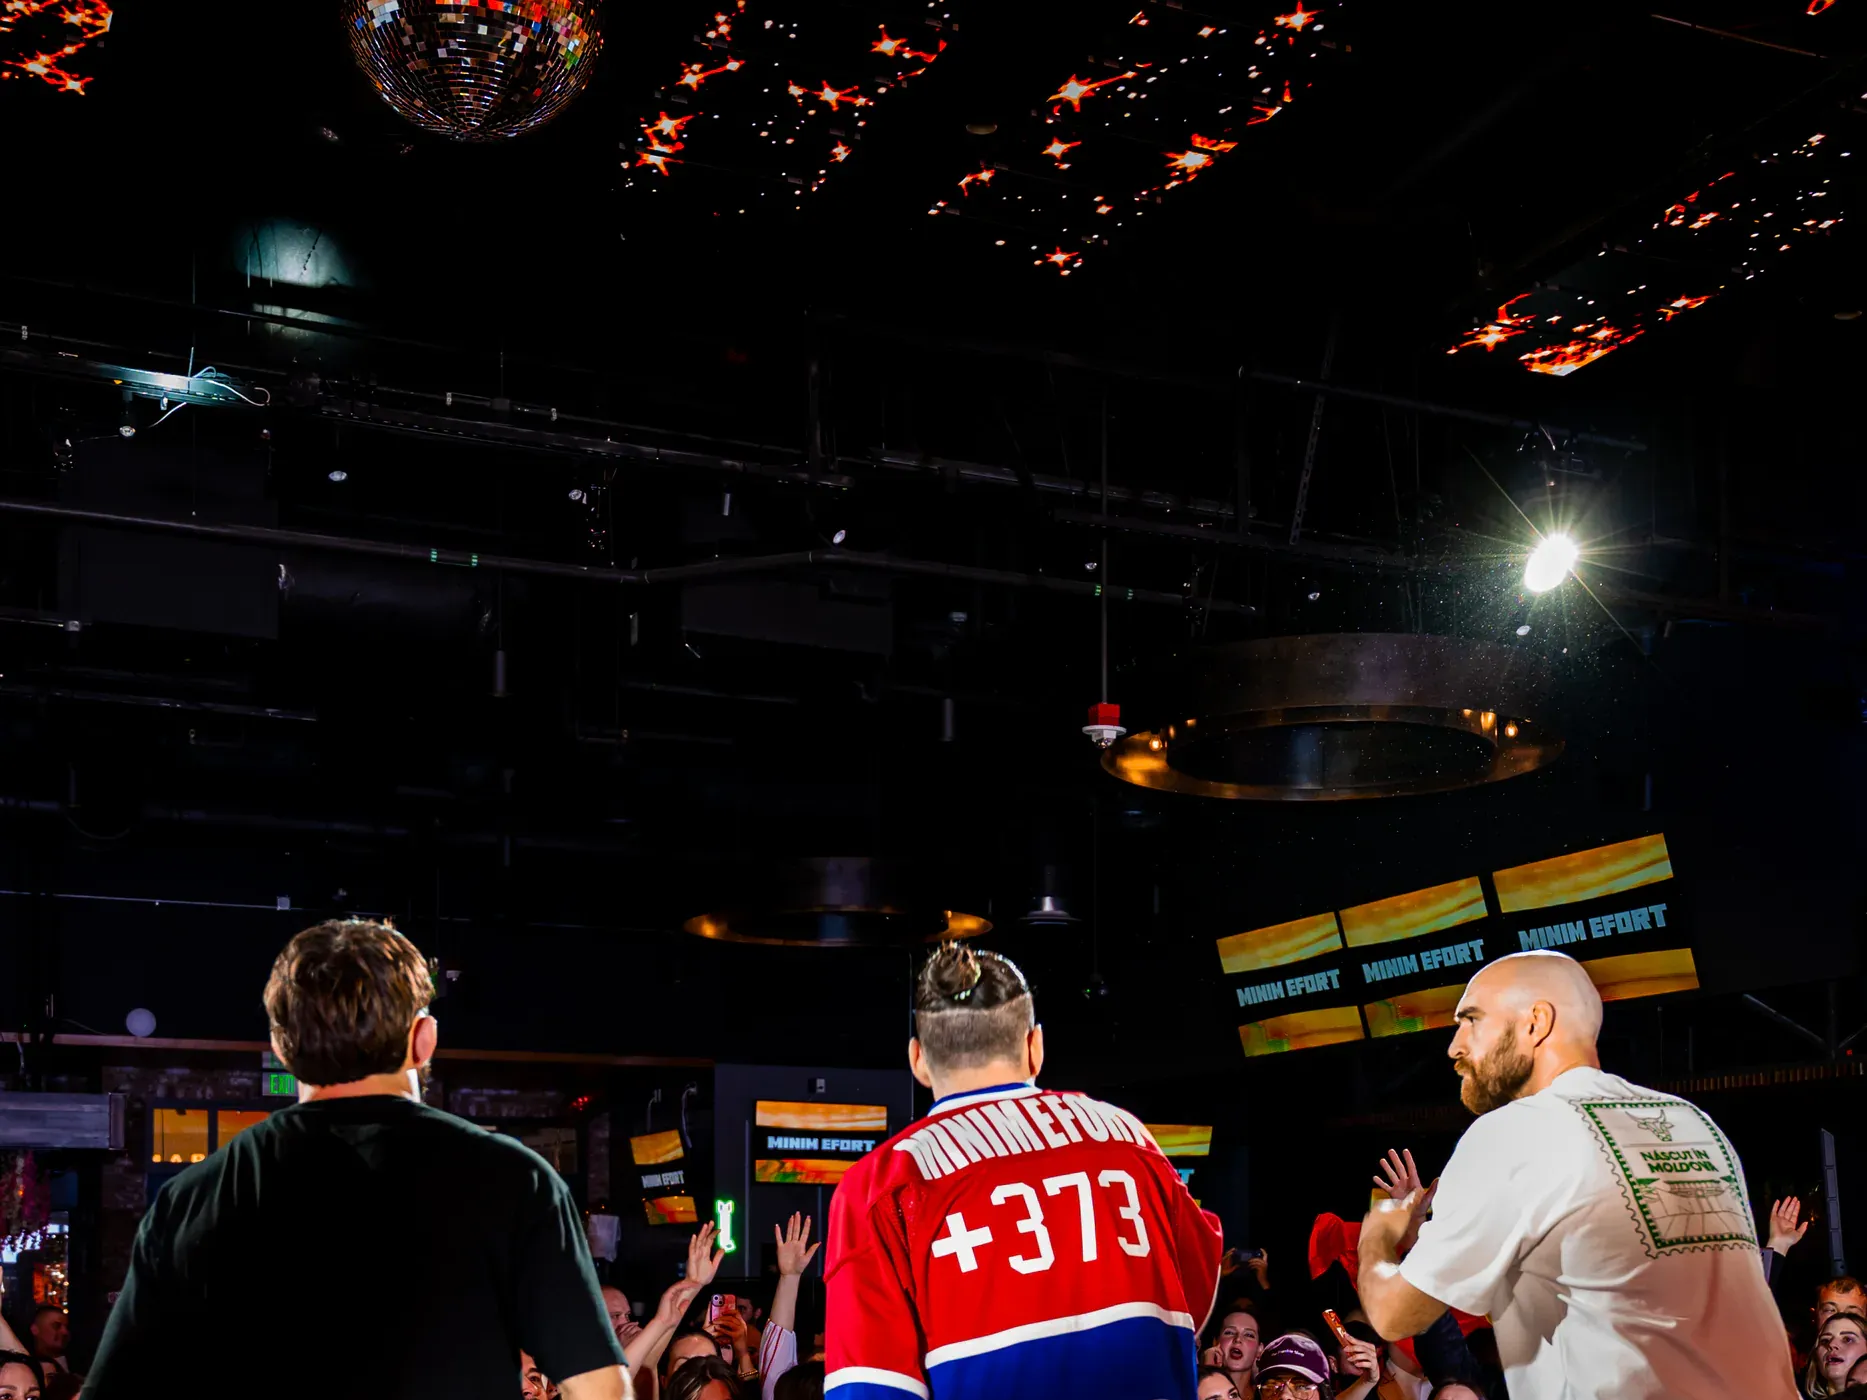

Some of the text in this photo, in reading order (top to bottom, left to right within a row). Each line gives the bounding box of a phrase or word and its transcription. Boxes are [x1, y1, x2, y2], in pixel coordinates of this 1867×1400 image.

[1517, 903, 1668, 952] MINIM EFORT
[1362, 939, 1485, 984] MINIM EFORT
[1236, 969, 1341, 1008] MINIM EFORT
[767, 1135, 876, 1152] MINIM EFORT
[1647, 1160, 1719, 1173] MOLDOVA
[931, 1169, 1151, 1275] +373
